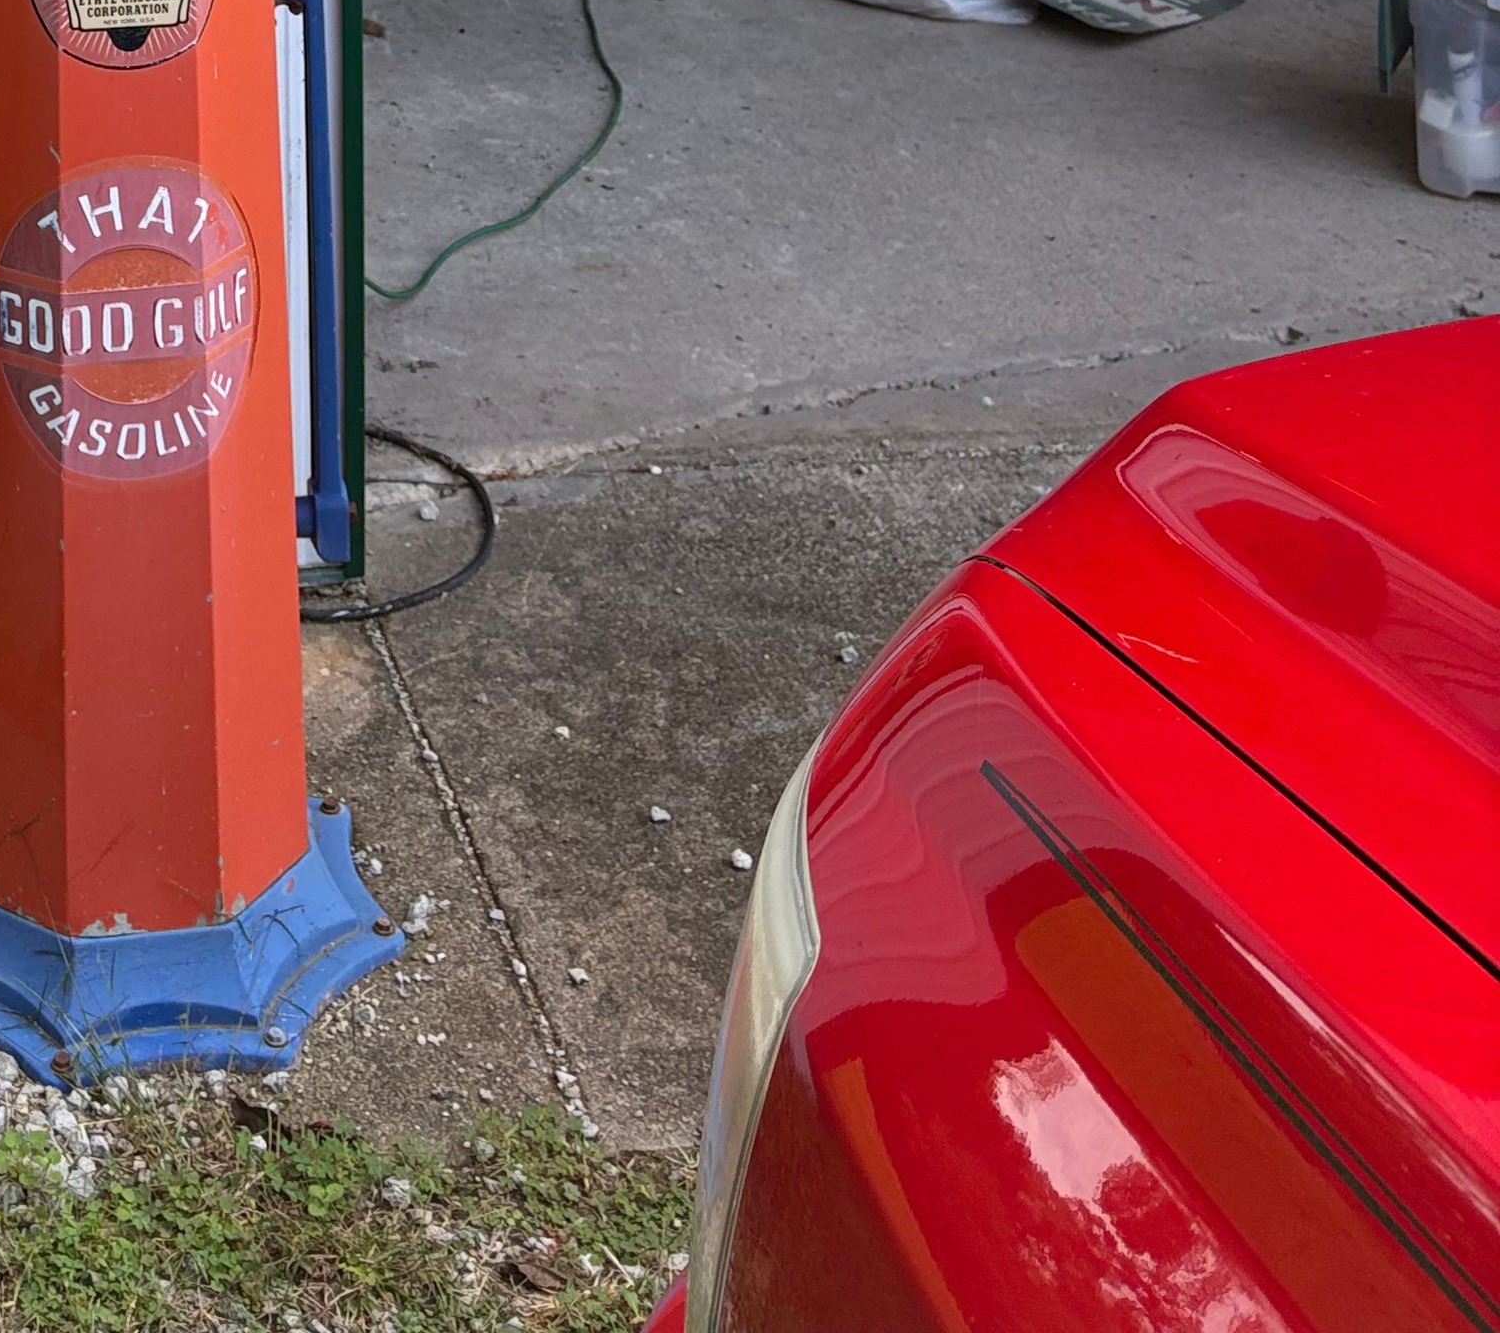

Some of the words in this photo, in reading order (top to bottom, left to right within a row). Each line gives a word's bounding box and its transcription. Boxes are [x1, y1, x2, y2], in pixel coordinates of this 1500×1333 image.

[87, 3, 170, 18] CORPORATION
[0, 290, 135, 358] GOOD
[154, 268, 248, 350] GULF
[28, 370, 233, 461] GASOLINE
